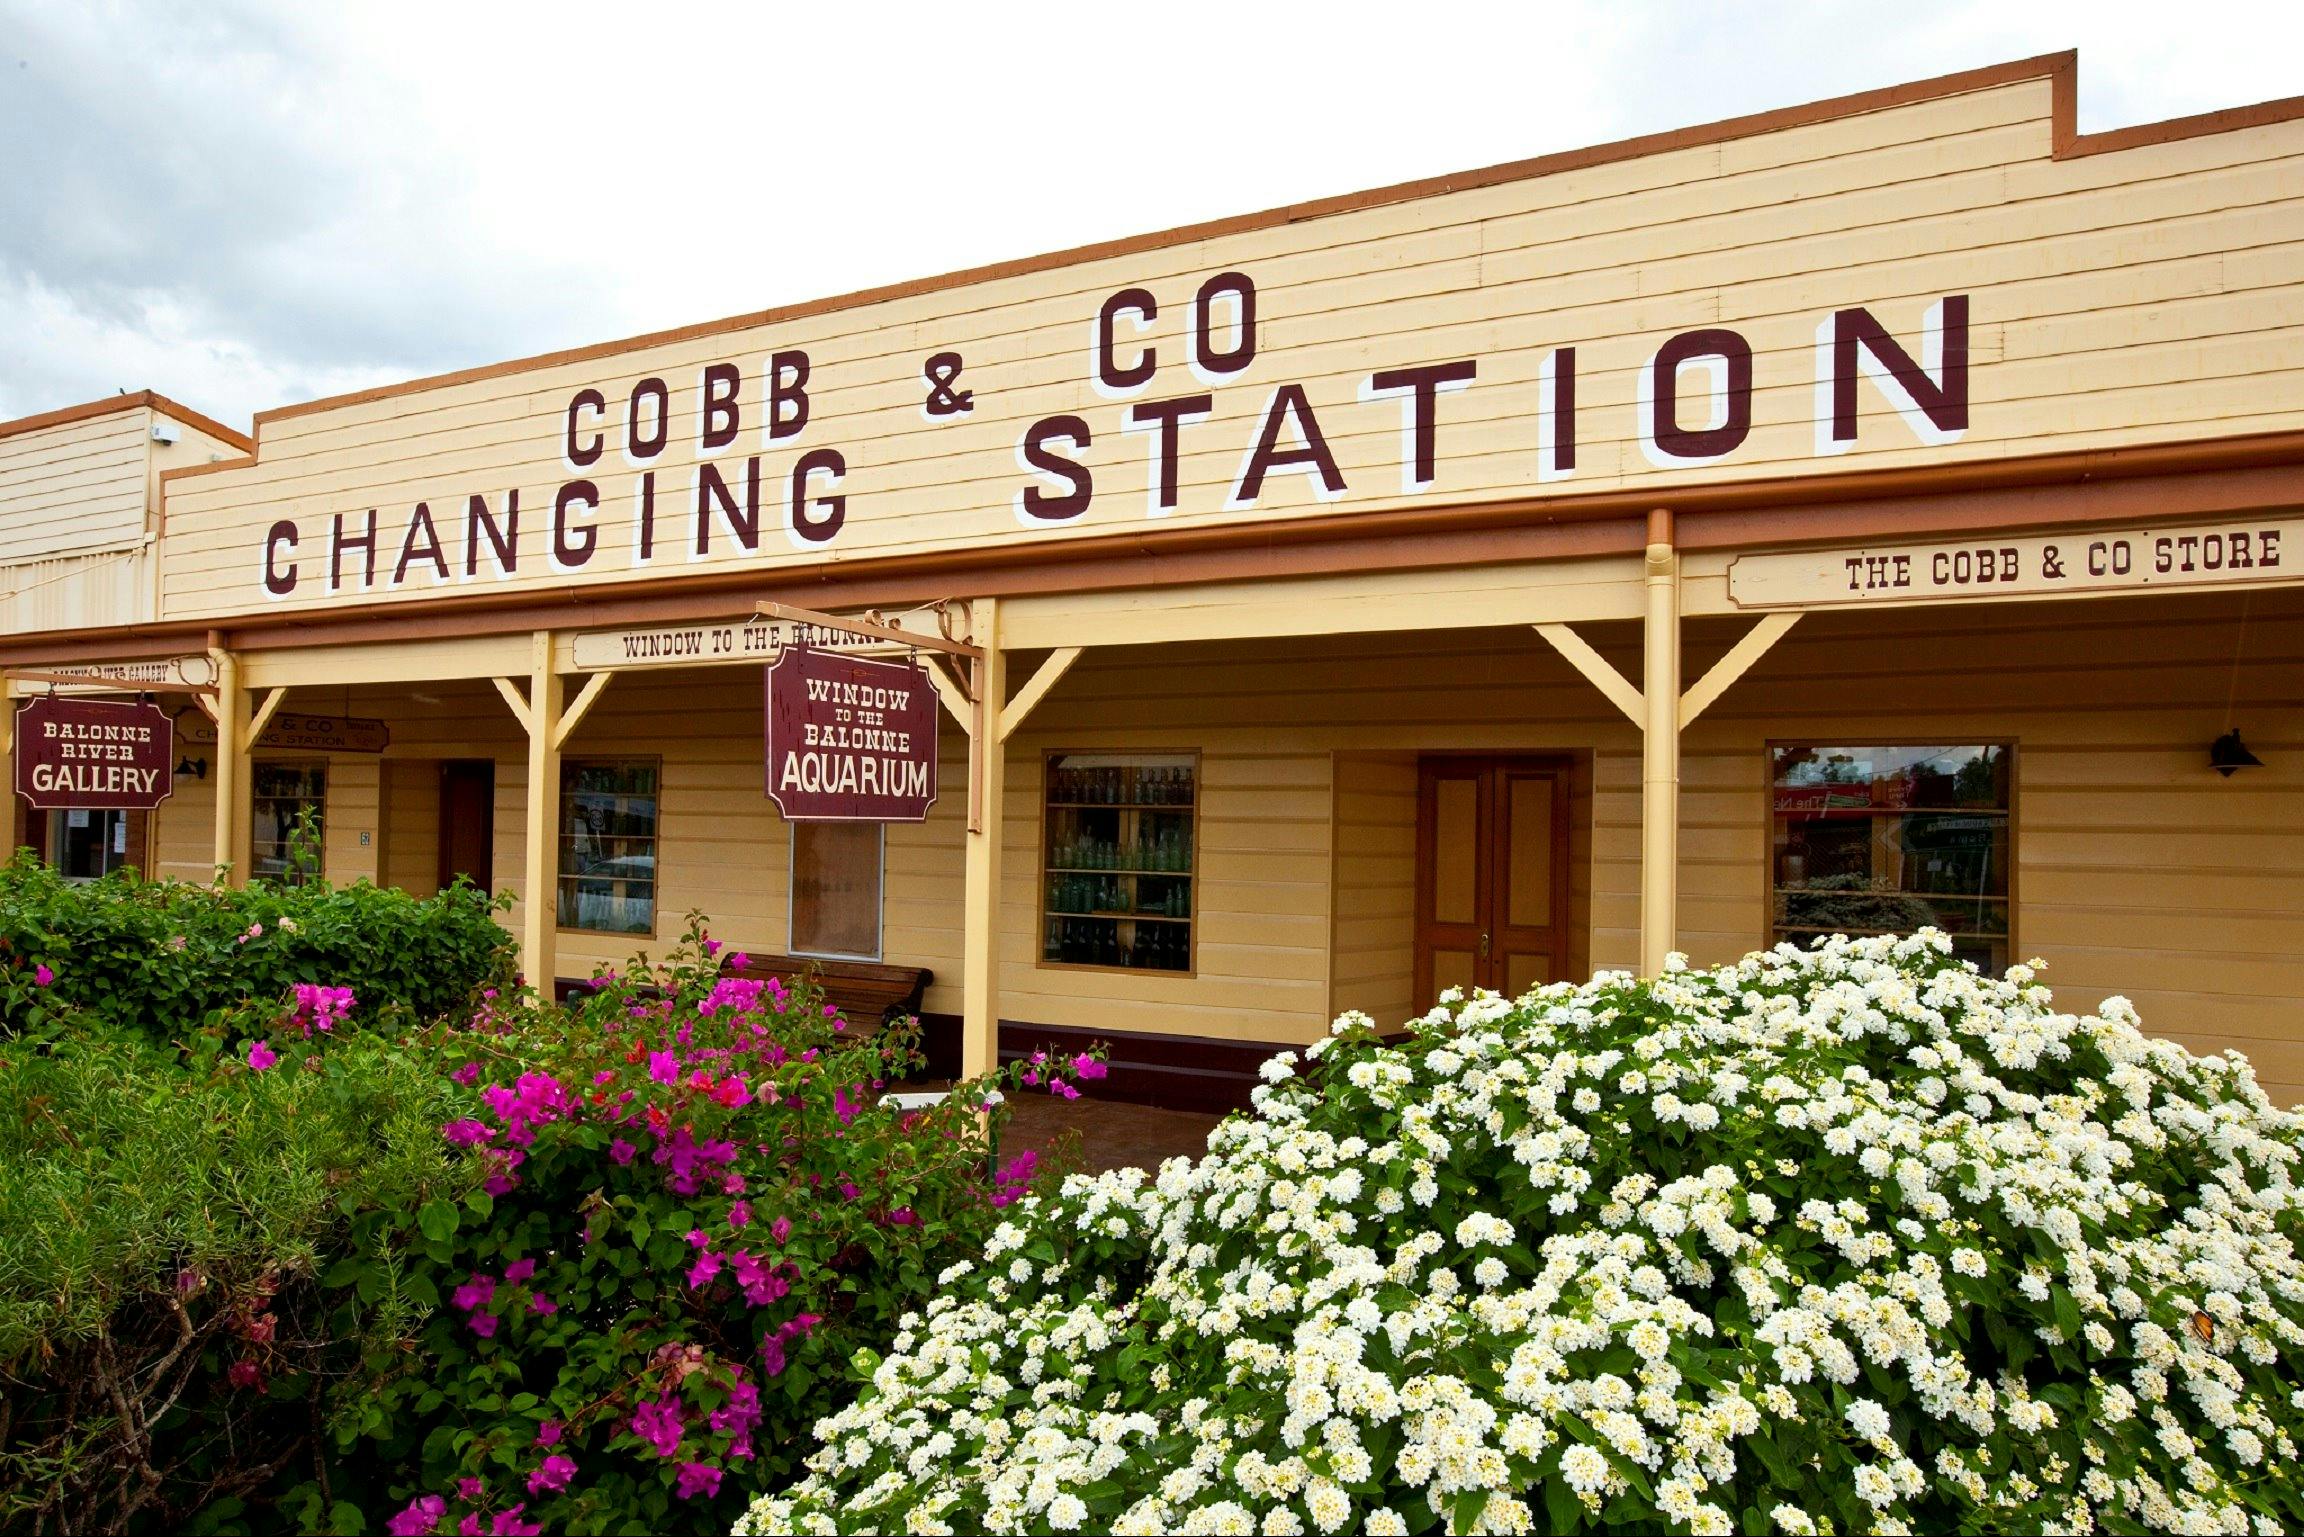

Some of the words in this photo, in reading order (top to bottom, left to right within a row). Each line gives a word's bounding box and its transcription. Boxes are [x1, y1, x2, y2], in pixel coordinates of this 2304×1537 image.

[567, 350, 811, 468] COBB
[924, 352, 974, 415] &
[1099, 272, 1257, 388] CO
[264, 448, 846, 595] CHANGING
[1022, 294, 1970, 520] STATION
[1845, 555, 1911, 590] THE
[1932, 547, 2020, 585] COBB
[2042, 545, 2066, 579] &
[2088, 540, 2132, 577] CO
[2155, 529, 2281, 573] STORE
[622, 630, 703, 659] WINDOW
[712, 628, 733, 653] TO
[743, 625, 780, 650] THE
[806, 679, 910, 711] WINDOW
[43, 721, 151, 743] BALONNE
[835, 708, 852, 722] TO
[857, 710, 884, 726] THE
[61, 743, 134, 761] RIVER
[286, 732, 346, 746] STATION
[804, 723, 910, 753] BALONNE
[32, 764, 159, 794] GALLERY
[780, 750, 928, 798] AQUARIUM
